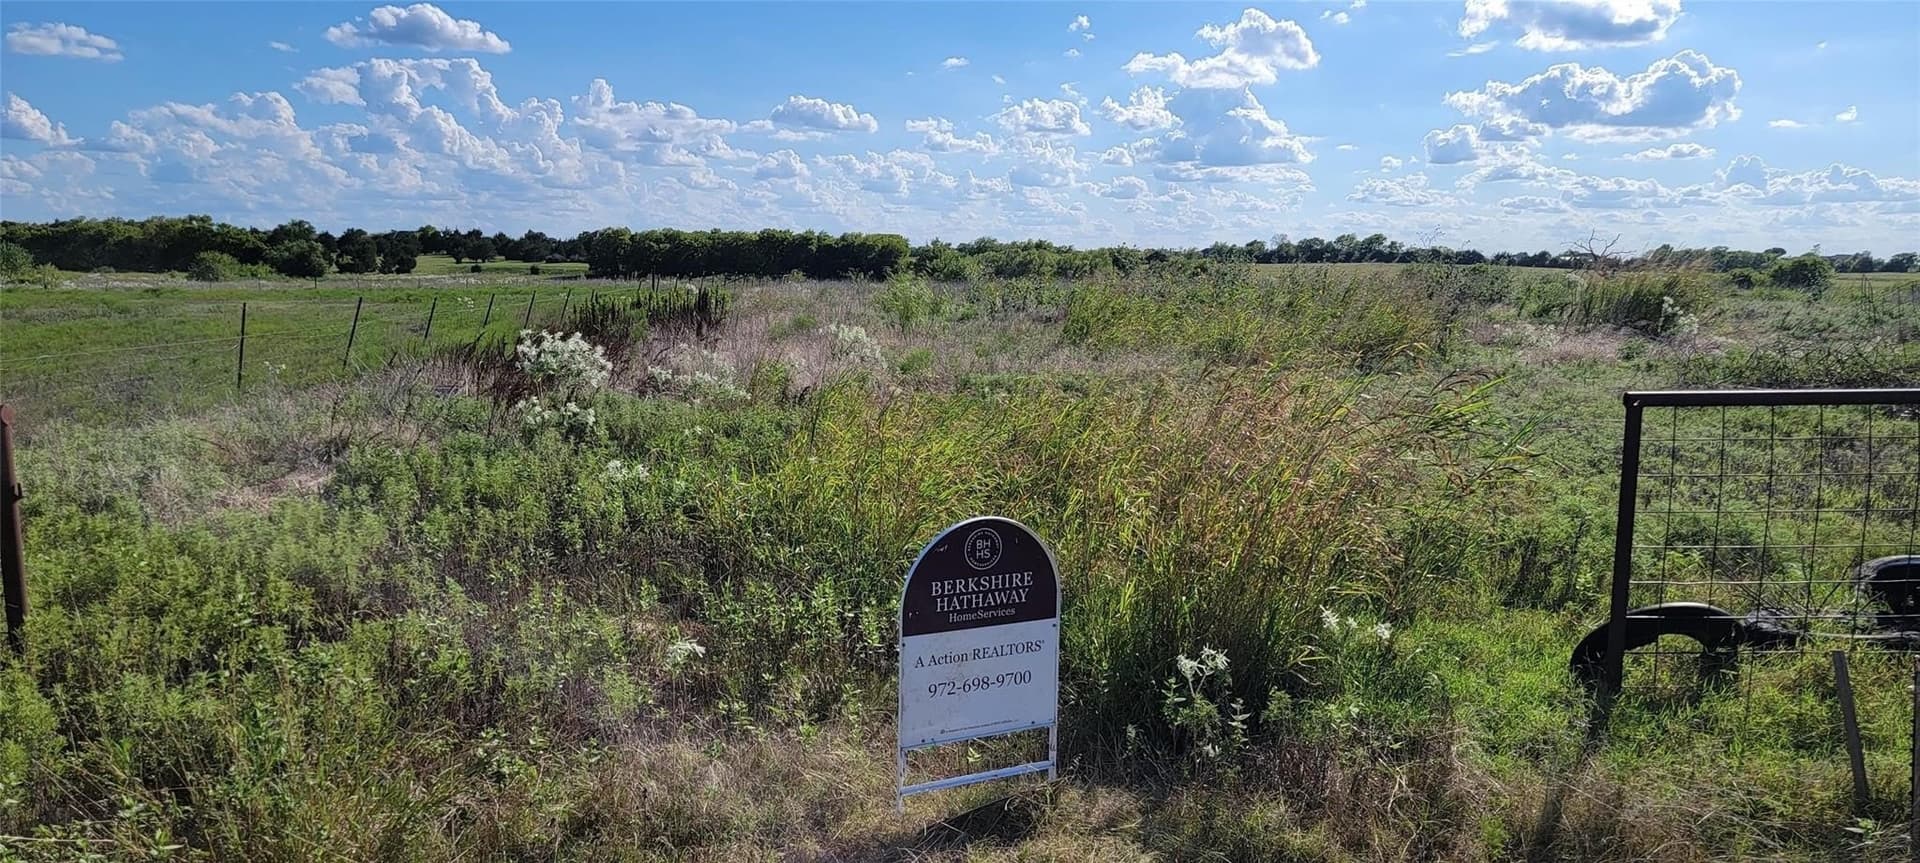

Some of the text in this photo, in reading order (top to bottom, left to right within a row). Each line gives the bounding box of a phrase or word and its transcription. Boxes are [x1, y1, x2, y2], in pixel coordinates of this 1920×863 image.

[976, 539, 991, 550] BH
[976, 549, 991, 560] HS
[931, 571, 1034, 597] BERKSHIRE
[936, 588, 1030, 613] HATHAWAY
[949, 607, 1016, 623] HomeServices
[914, 656, 925, 669] A
[928, 651, 969, 667] Action
[928, 670, 1032, 699] 972-698-9700
